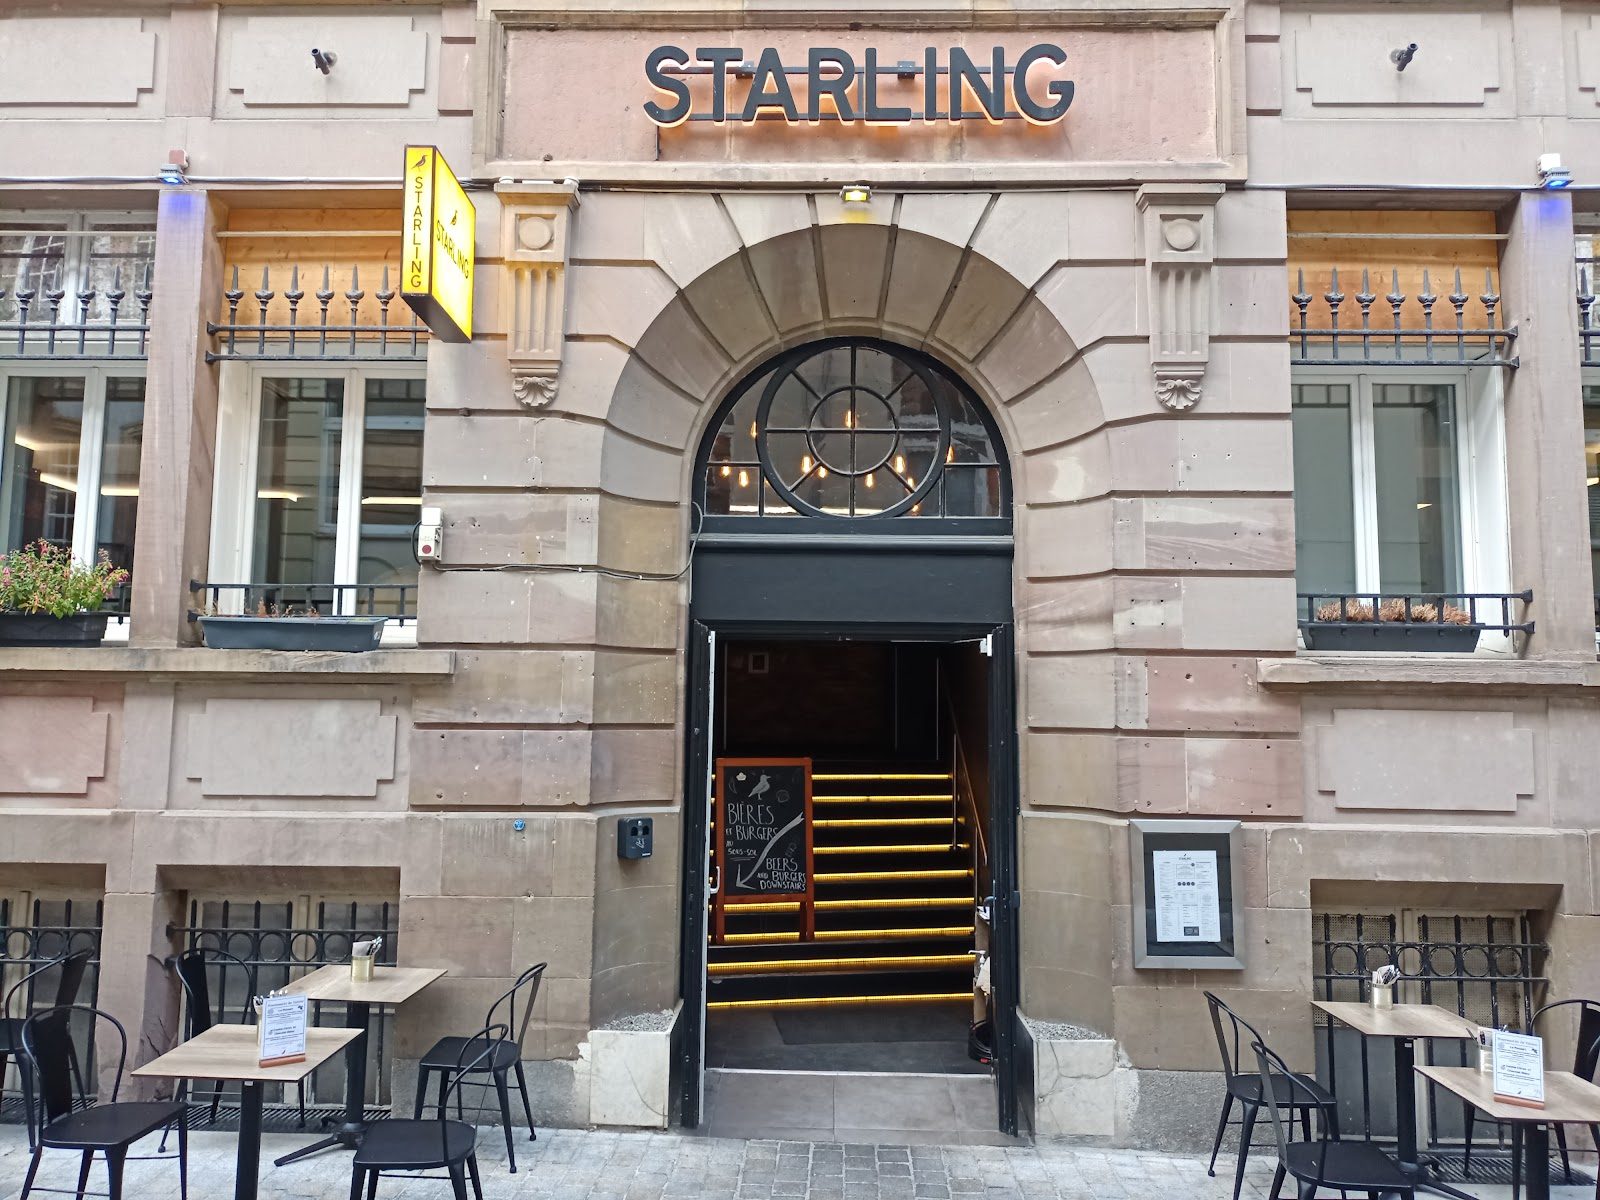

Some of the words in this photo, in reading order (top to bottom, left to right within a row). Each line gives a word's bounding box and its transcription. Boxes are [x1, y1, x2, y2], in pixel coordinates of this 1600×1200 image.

[643, 43, 1075, 125] STARLING
[410, 176, 423, 288] STARLING
[436, 219, 469, 280] STARLING
[728, 801, 774, 824] BIÈRES
[735, 825, 779, 840] BURGERS
[766, 857, 798, 871] BEERS
[760, 880, 806, 891] DOWNSTAIRS
[772, 870, 806, 883] BURGERS
